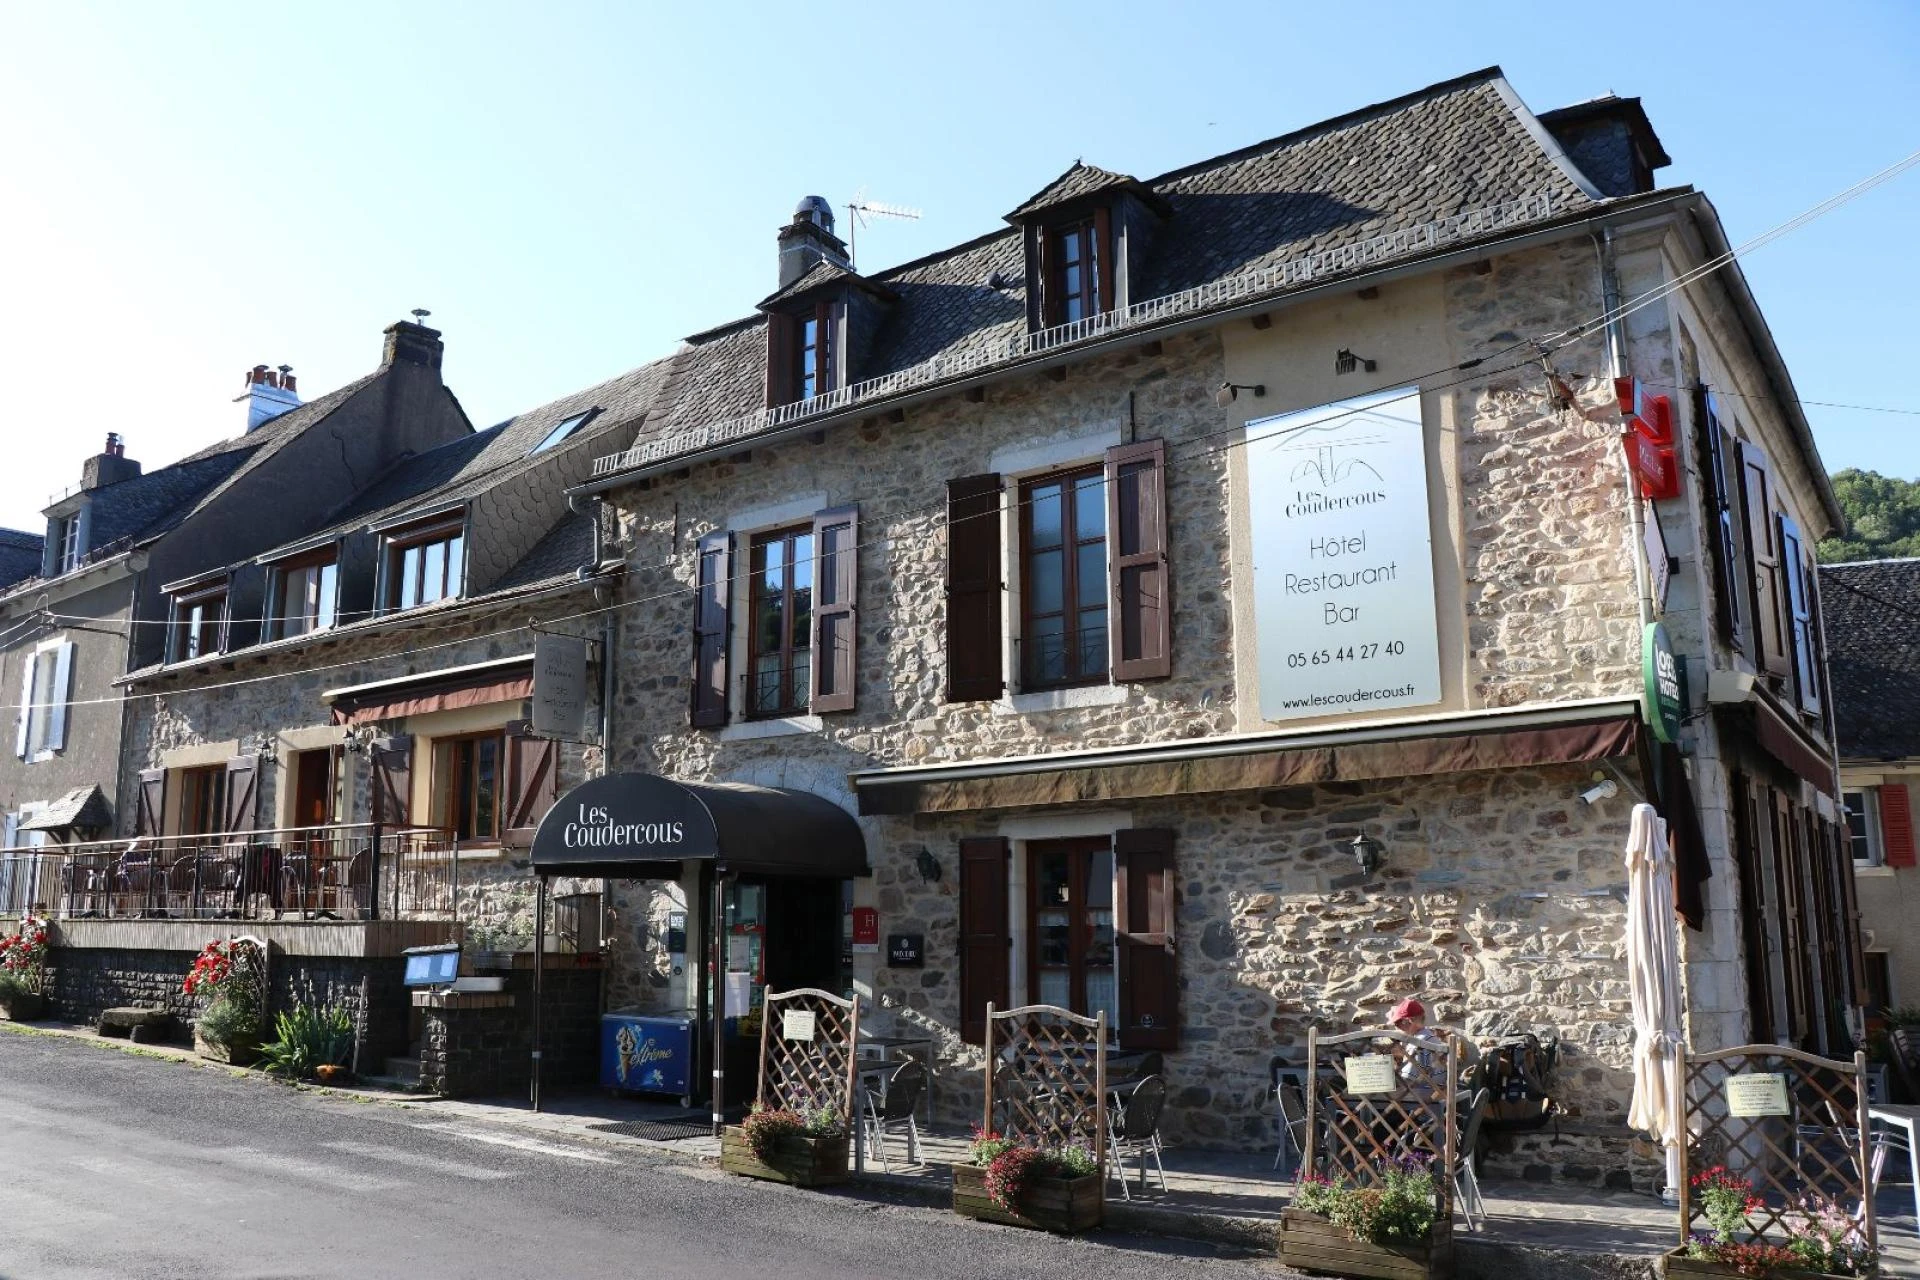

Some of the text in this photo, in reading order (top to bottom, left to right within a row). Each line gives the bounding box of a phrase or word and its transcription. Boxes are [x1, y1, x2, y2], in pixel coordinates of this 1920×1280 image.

[1285, 489, 1386, 518] Coudercous
[1297, 490, 1321, 503] Les
[1310, 529, 1366, 559] Hôtel
[1285, 561, 1397, 595] Restaurant
[1324, 602, 1360, 625] Bar
[1288, 640, 1404, 668] 05 65 44 27 40
[1282, 684, 1415, 709] www.lescoudercous.fr
[579, 803, 608, 825] Les
[564, 818, 684, 848] Coudercous
[865, 914, 874, 927] H
